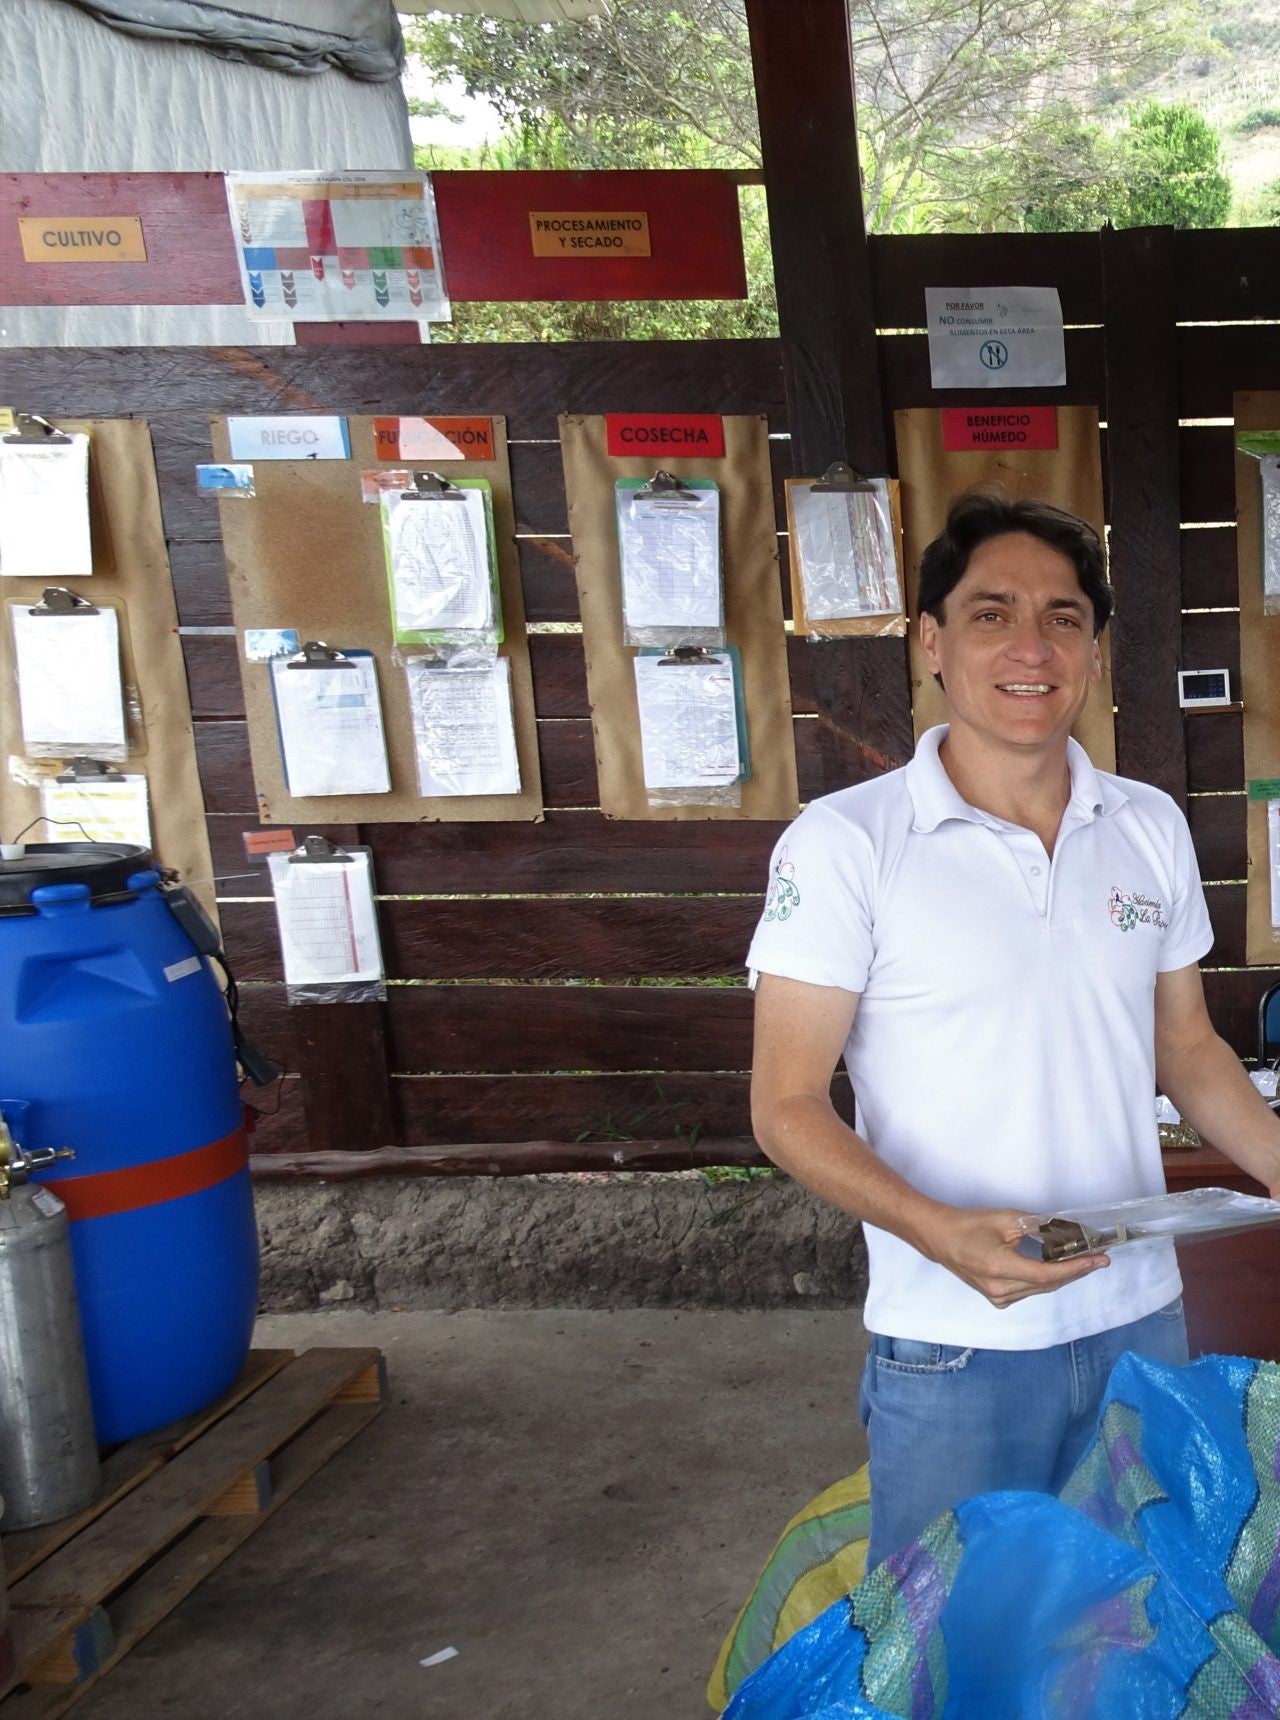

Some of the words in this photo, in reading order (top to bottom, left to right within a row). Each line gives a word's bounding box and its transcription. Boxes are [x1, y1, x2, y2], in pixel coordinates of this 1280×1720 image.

[536, 219, 642, 231] PROCESAMIENTO
[42, 230, 122, 247] CULTIVO
[558, 236, 566, 248] Y
[570, 236, 623, 248] SECADO
[945, 302, 960, 310] POR
[961, 302, 984, 310] FAVOR
[939, 315, 955, 325] NO
[966, 414, 1031, 427] BENEFICIO
[260, 430, 318, 446] RIEGO
[620, 427, 710, 443] COSECHA
[972, 428, 1027, 443] HÚMEDO
